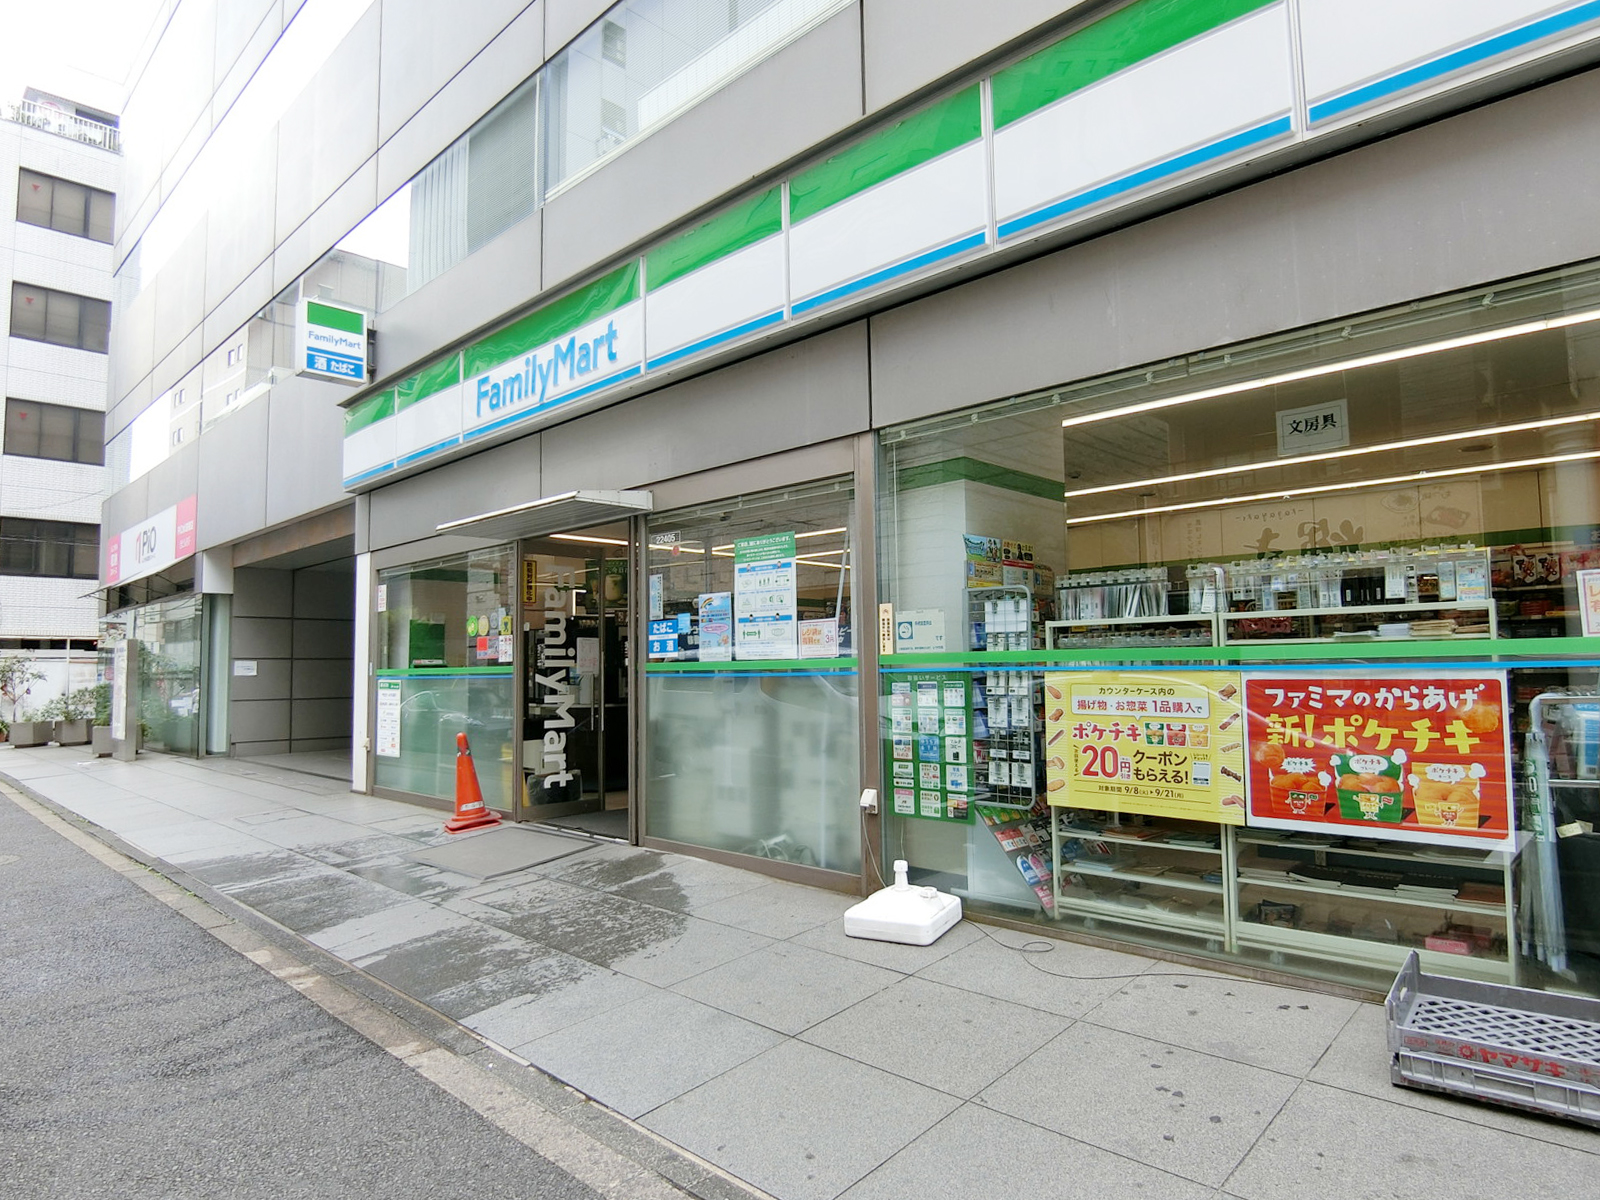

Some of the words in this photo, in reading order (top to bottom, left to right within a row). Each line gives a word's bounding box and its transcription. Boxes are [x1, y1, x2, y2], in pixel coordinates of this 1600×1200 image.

[308, 330, 361, 350] FamilyMart
[314, 355, 328, 371] 酒
[330, 360, 356, 375] たばこ
[476, 319, 619, 418] FamilyMart
[1286, 412, 1337, 435] 文房具
[655, 533, 676, 545] 22405
[653, 622, 673, 634] たばこ
[535, 565, 576, 790] FamilyMart
[1098, 687, 1176, 696] カウンターケース内の
[1265, 683, 1486, 713] ファミマのからあげ
[1072, 721, 1142, 742] ポケチキ
[1081, 744, 1119, 779] 20
[1132, 749, 1188, 767] クーポン
[1354, 758, 1382, 766] ポケチキ
[1133, 767, 1189, 785] もらえる!
[1431, 767, 1459, 775] ポケチキ
[1098, 784, 1123, 793] 対象期間
